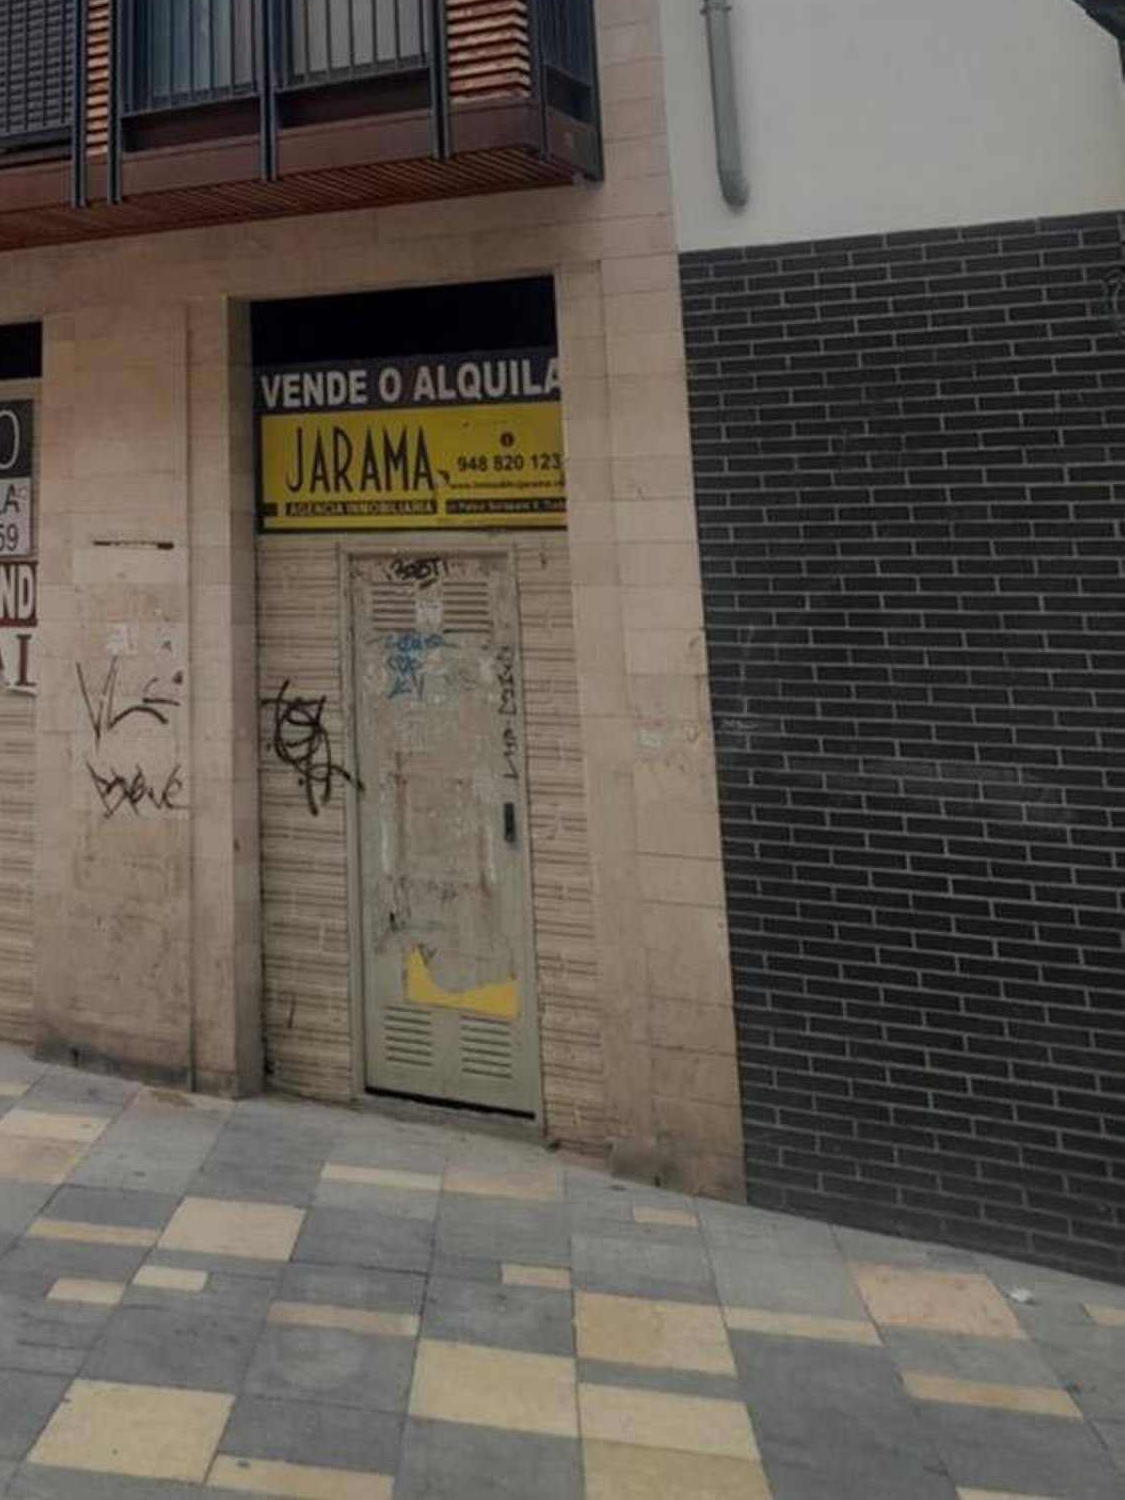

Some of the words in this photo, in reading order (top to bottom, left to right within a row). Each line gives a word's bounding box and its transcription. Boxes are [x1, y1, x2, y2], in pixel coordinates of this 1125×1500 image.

[261, 369, 367, 408] VENDE
[378, 367, 402, 401] O
[413, 357, 560, 401] ALQUILA
[286, 424, 435, 493] JARAMA
[457, 455, 487, 472] 948
